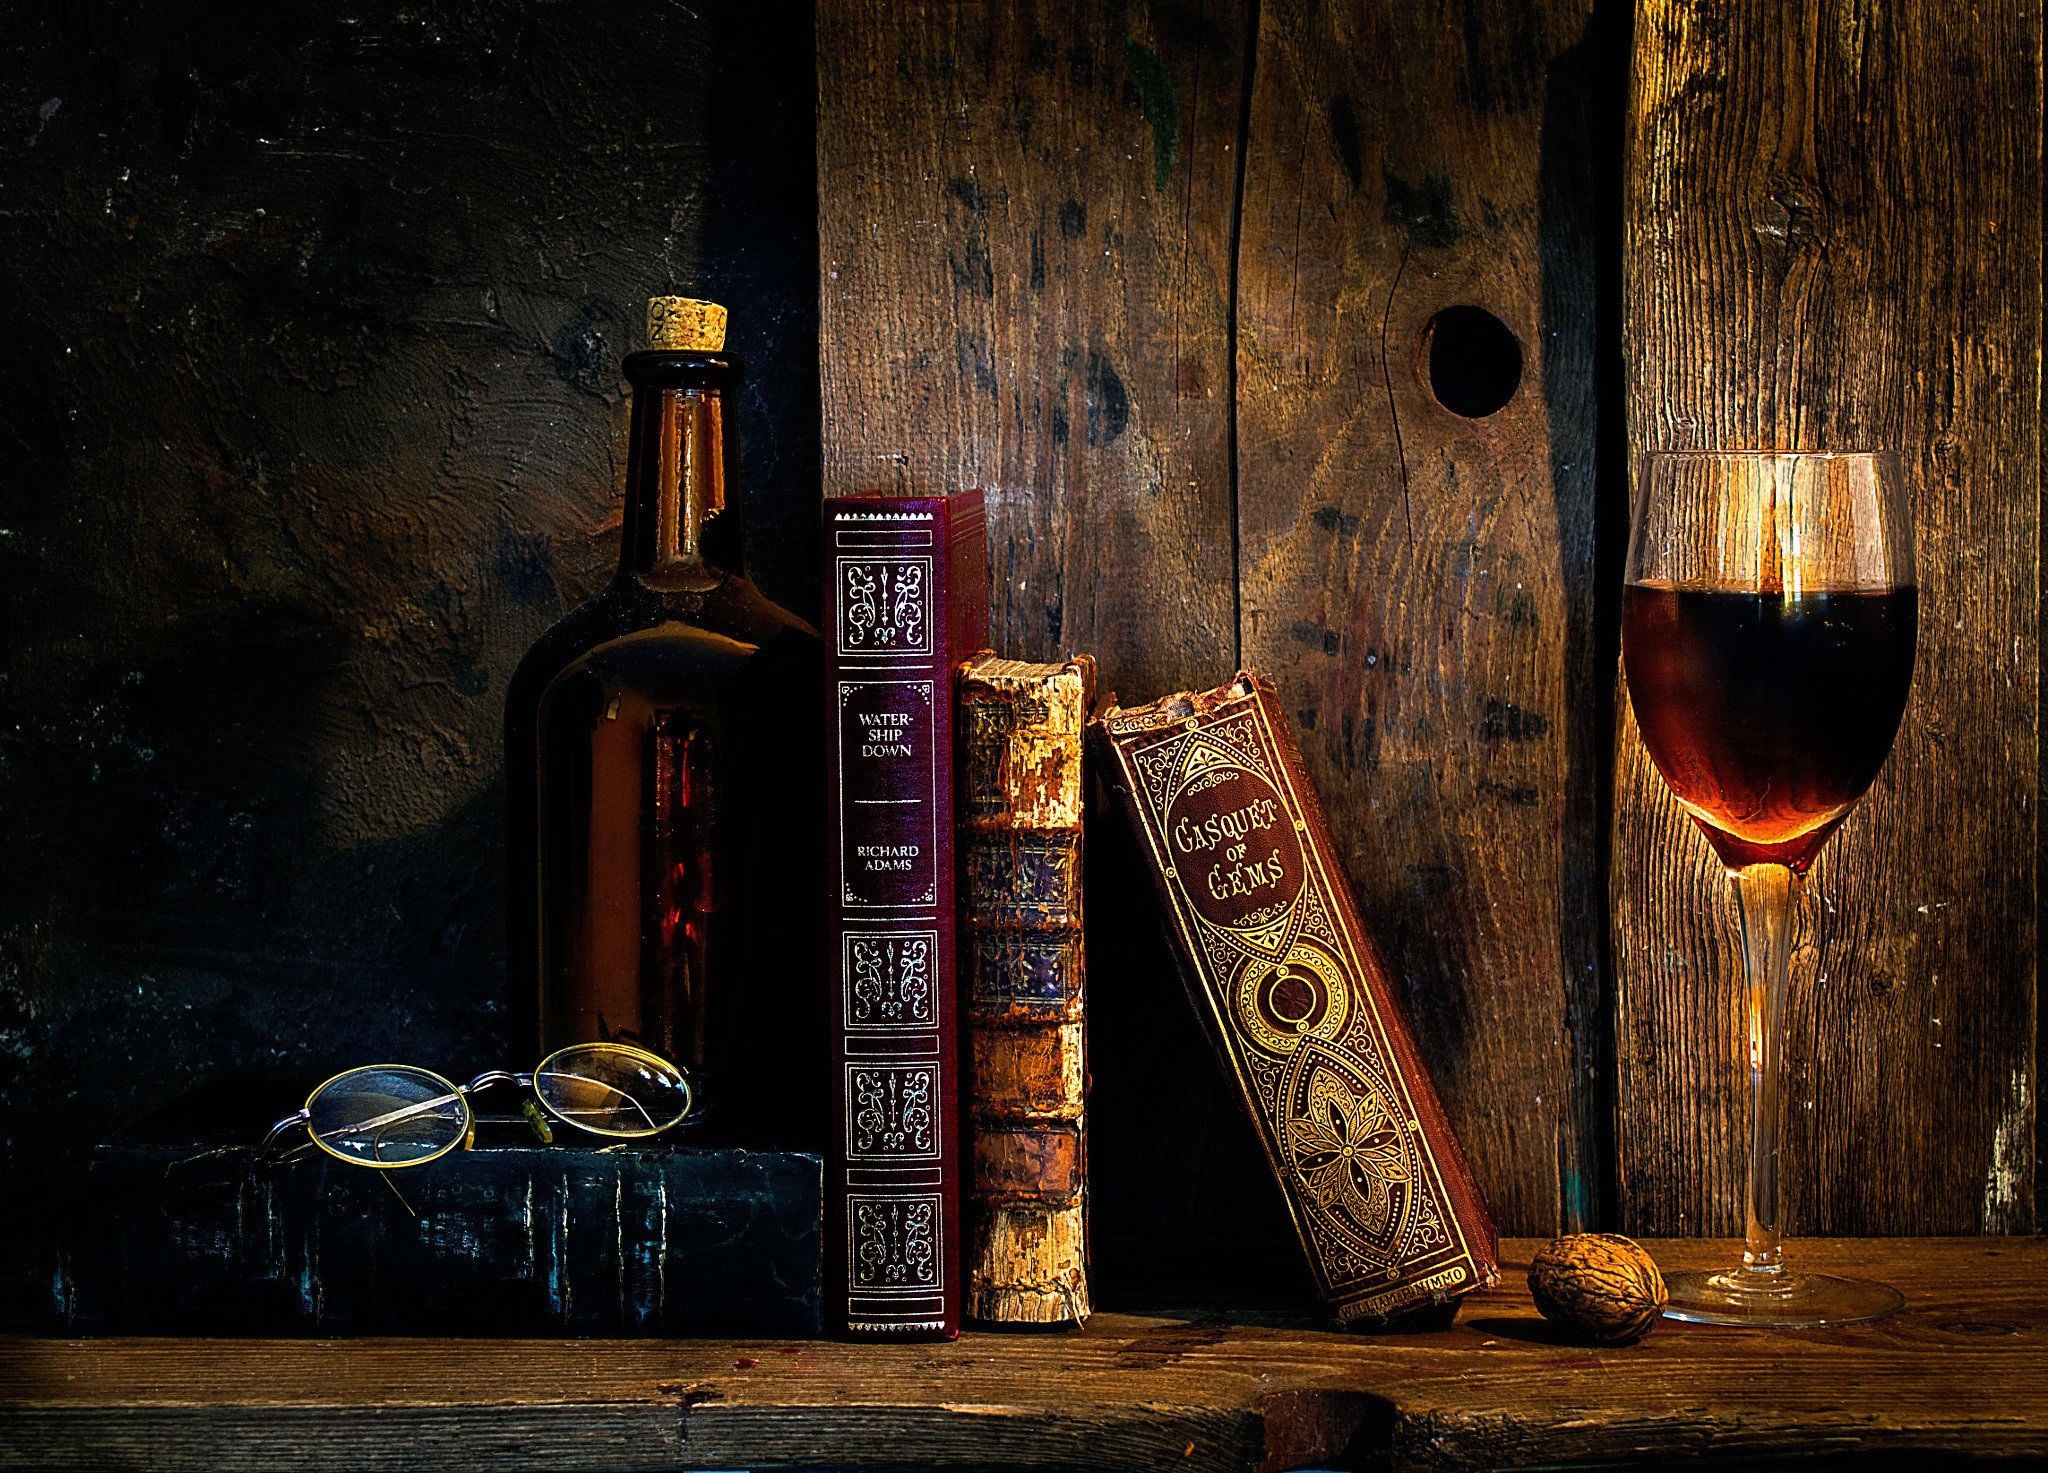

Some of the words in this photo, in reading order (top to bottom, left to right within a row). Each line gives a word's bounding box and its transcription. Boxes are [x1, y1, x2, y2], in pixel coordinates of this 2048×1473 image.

[858, 713, 914, 726] WATER-
[868, 729, 903, 742] SHIP
[862, 744, 912, 758] DOWN
[1175, 798, 1277, 853] CASQUET
[857, 846, 919, 858] RICHARD
[1226, 843, 1247, 862] OF
[865, 859, 913, 871] ADAMS
[1208, 849, 1284, 900] GEMS
[1411, 1268, 1463, 1295] NIMMO
